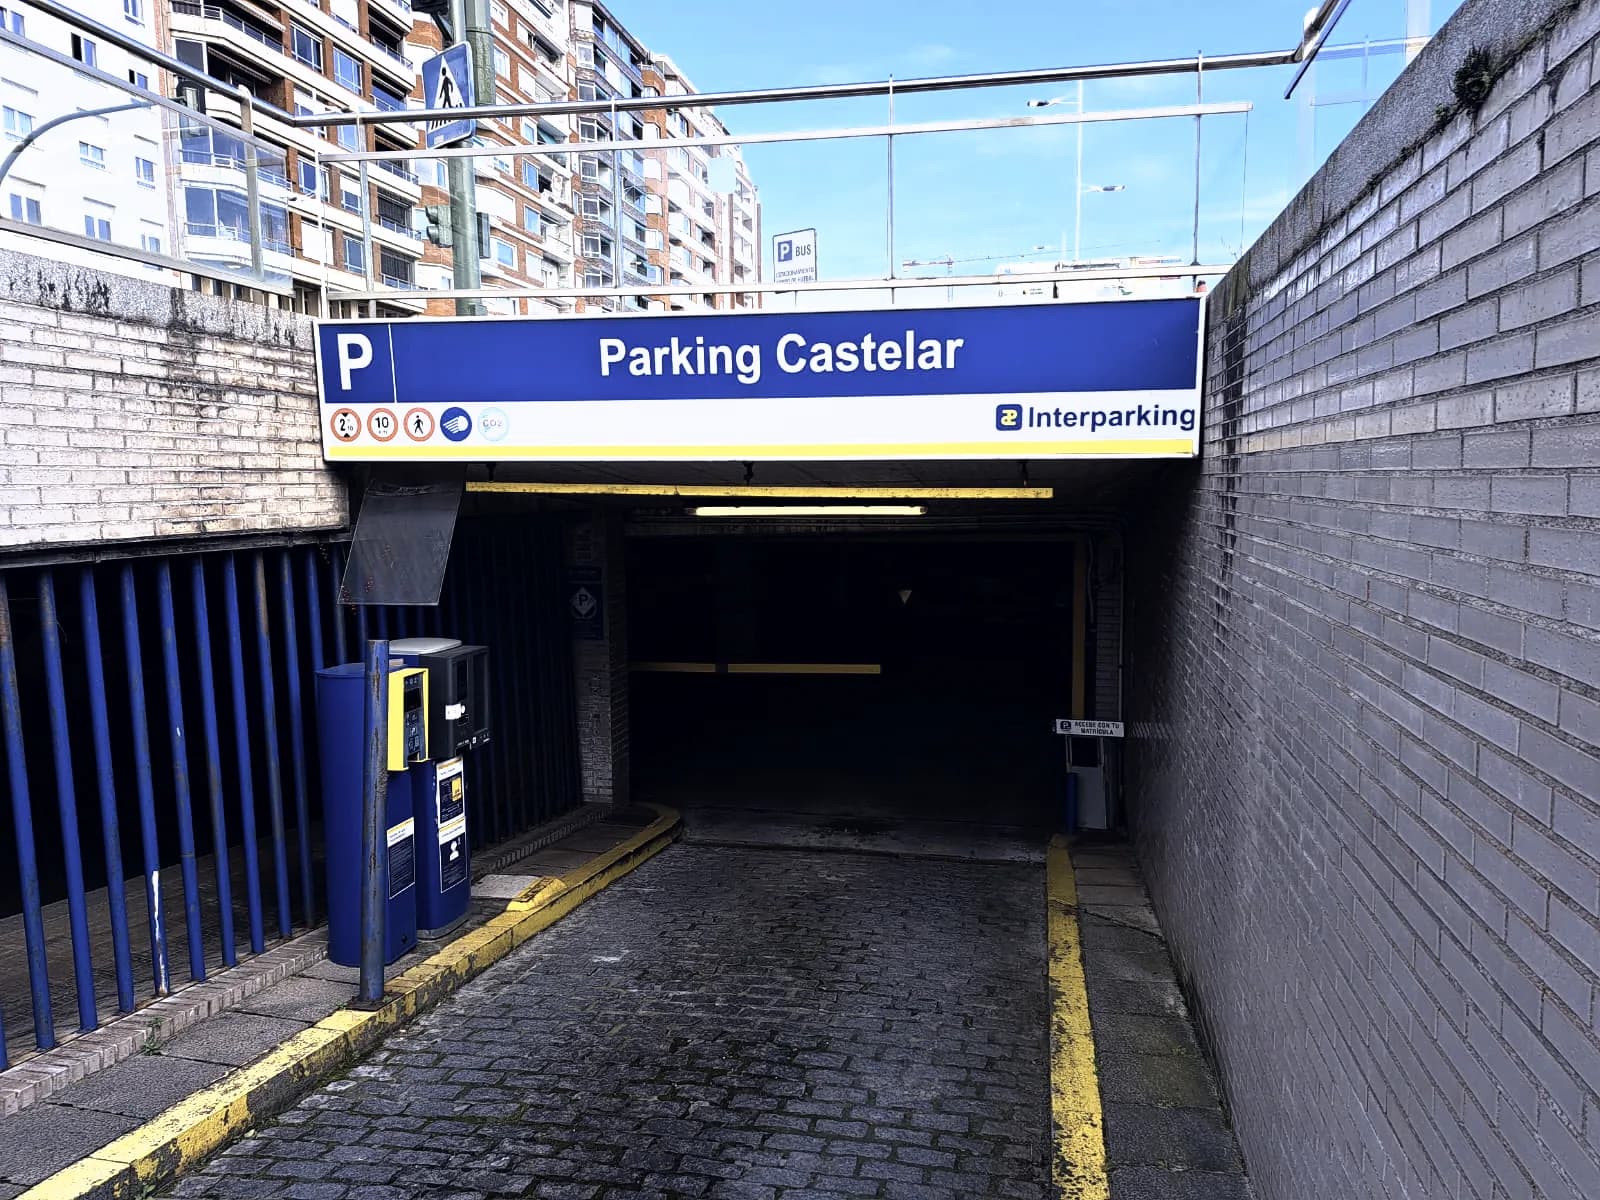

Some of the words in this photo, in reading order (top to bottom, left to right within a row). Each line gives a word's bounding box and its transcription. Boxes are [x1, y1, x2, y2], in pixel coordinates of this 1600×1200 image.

[780, 243, 790, 260] P
[796, 244, 812, 256] BUS
[337, 333, 373, 391] P
[600, 337, 762, 385] Parking
[776, 330, 964, 374] Castelar
[374, 416, 389, 429] 10
[1029, 404, 1195, 432] Interparking
